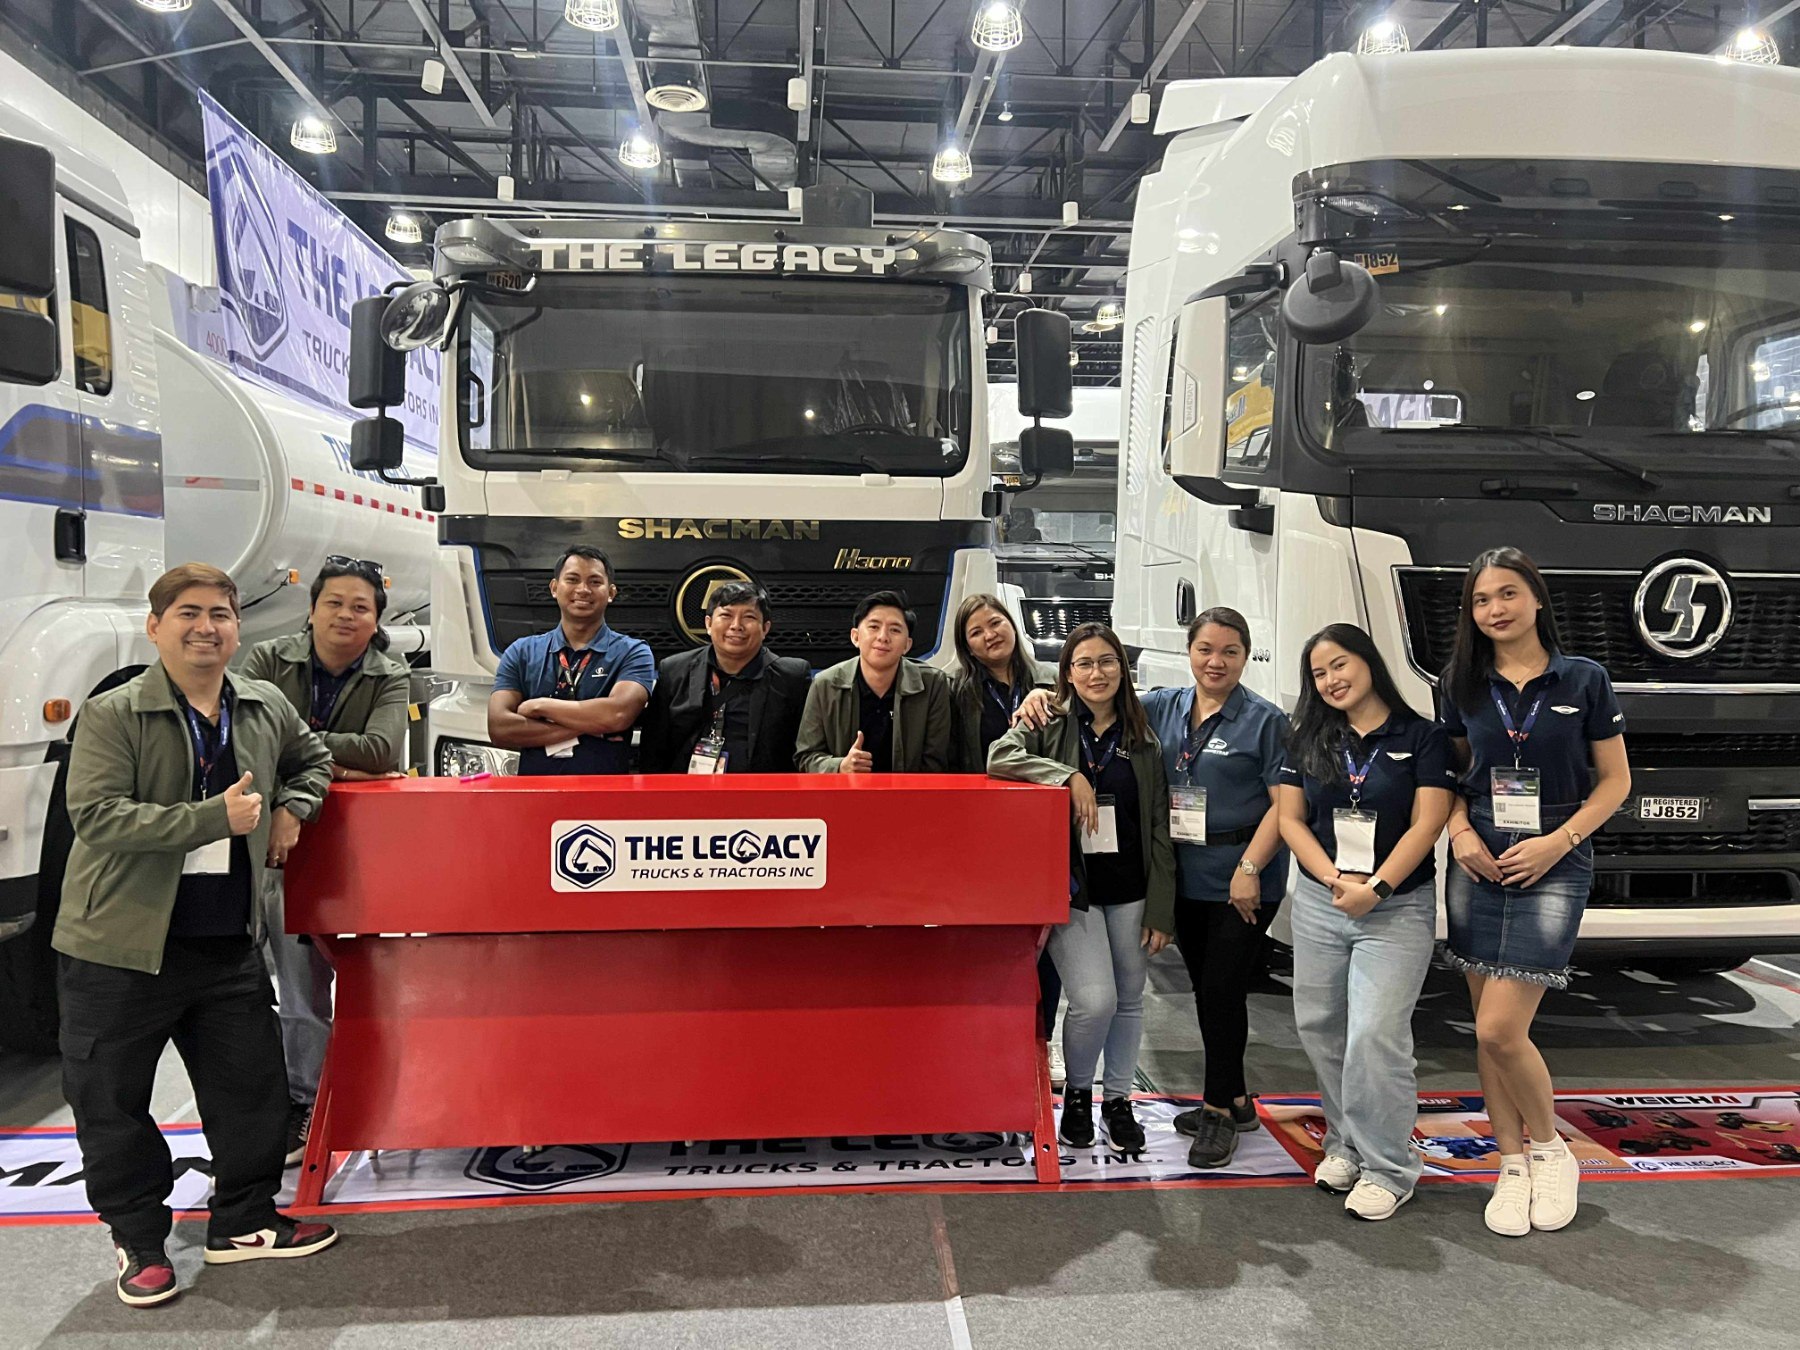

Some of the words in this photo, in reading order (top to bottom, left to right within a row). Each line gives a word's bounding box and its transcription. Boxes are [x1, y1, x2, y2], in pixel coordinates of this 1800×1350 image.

[530, 243, 643, 269] THE
[673, 243, 895, 274] LEGACY
[287, 218, 350, 330] THE
[302, 329, 350, 377] TRUCK
[1593, 503, 1772, 523] SHACMAN
[618, 518, 821, 541] SHACMAN
[833, 548, 912, 570] H3000
[1094, 572, 1114, 580] SH
[1643, 799, 1651, 807] M
[1653, 798, 1698, 806] REGISTERED
[1643, 808, 1650, 817] 3
[1652, 806, 1697, 818] J852
[624, 836, 683, 861] THE
[692, 829, 821, 864] LEGACY
[630, 868, 689, 879] TRUCKS
[693, 867, 704, 878] &
[708, 867, 786, 878] TRACTORS
[789, 866, 814, 877] INC
[1606, 1095, 1742, 1106] WEICHAI
[664, 1161, 819, 1176] TRUCKS
[832, 1160, 858, 1172] &
[873, 1155, 1076, 1170] TRACTOS
